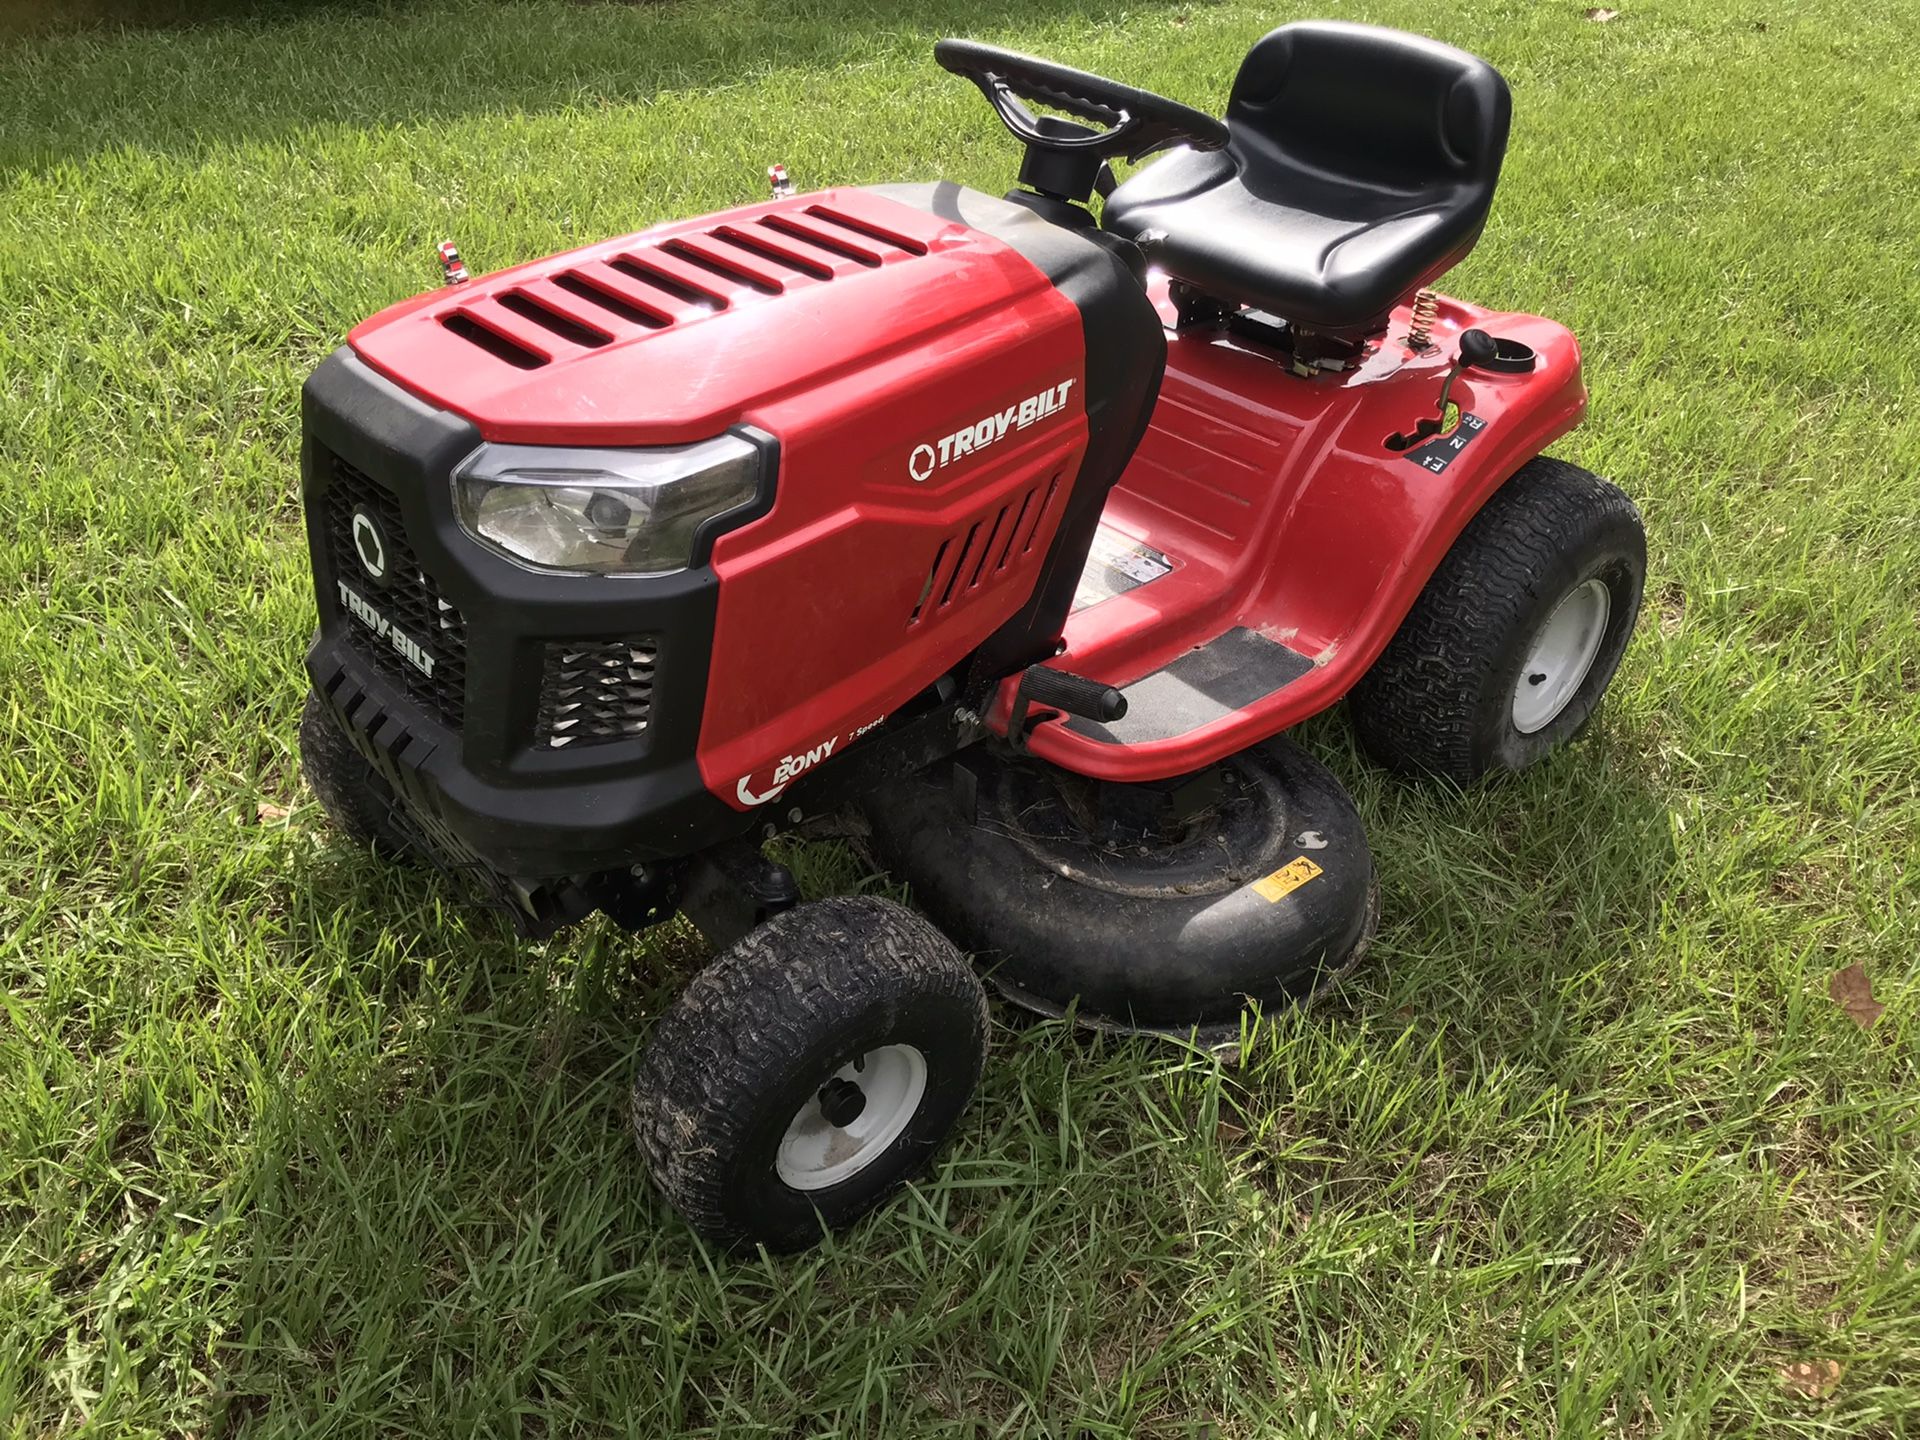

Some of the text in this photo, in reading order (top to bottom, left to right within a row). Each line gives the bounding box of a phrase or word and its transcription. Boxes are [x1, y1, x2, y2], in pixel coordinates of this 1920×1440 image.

[937, 378, 1074, 468] TROY-BILT
[1449, 438, 1464, 449] N
[1469, 419, 1483, 430] R
[1430, 462, 1443, 472] F
[337, 580, 435, 679] TROY-BILT
[773, 715, 885, 786] PONY 7 Speed
